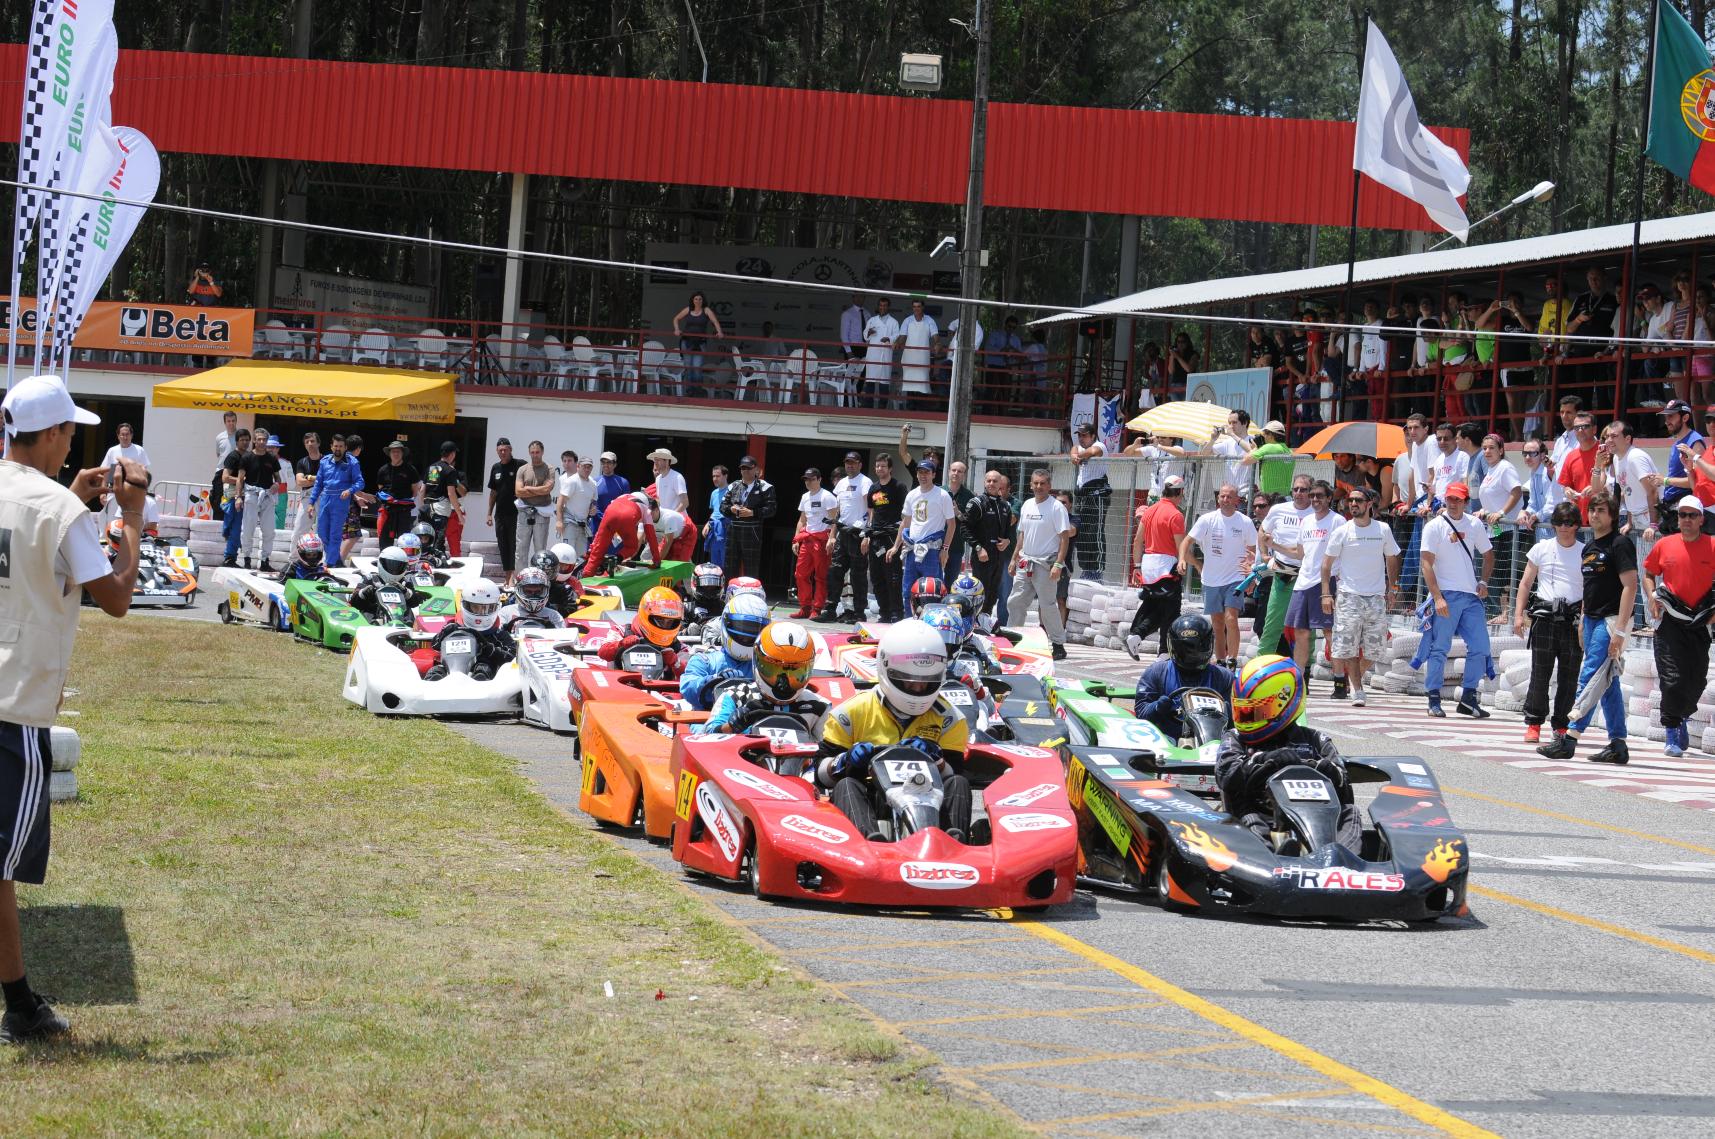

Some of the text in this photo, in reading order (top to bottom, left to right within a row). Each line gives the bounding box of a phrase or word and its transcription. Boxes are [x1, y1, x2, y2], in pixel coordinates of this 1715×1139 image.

[53, 23, 74, 107] EURO
[92, 190, 116, 250] EURO
[151, 308, 230, 343] Beta
[192, 399, 360, 418] www.pestronix.pt
[244, 588, 265, 611] PMH
[1195, 697, 1217, 705] 115
[767, 729, 789, 737] 17
[890, 761, 923, 772] 74
[678, 773, 693, 816] 74
[1088, 780, 1128, 838] WARNING
[904, 865, 977, 880] liztrez
[1301, 871, 1404, 891] RACES
